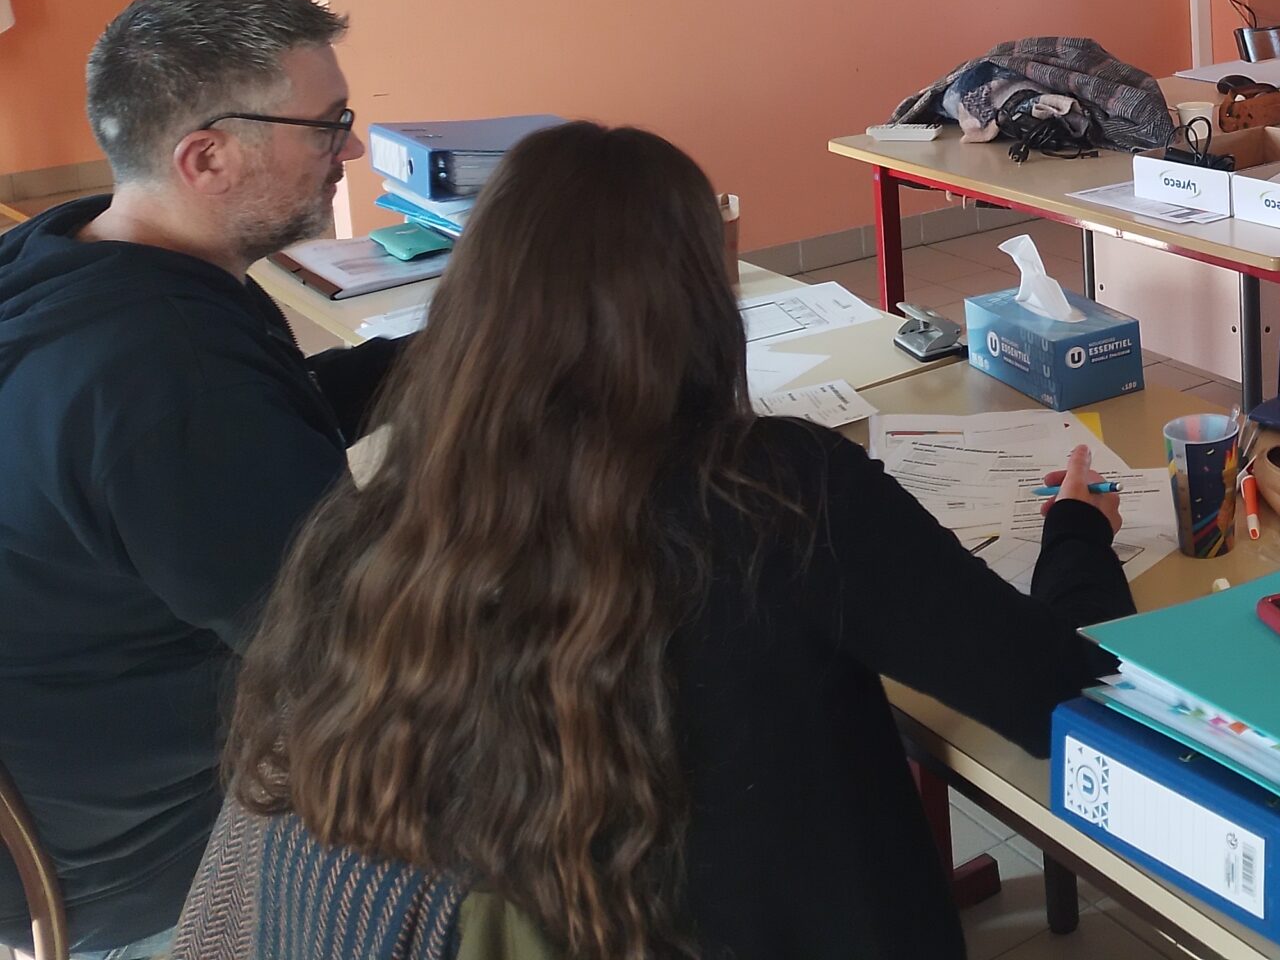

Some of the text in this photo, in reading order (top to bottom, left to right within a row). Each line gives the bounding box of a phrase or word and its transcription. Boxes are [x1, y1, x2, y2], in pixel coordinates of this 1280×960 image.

[1163, 176, 1197, 194] Lyreco
[1001, 342, 1030, 365] ESSENTIEL
[1088, 339, 1132, 356] ESSENTIEL
